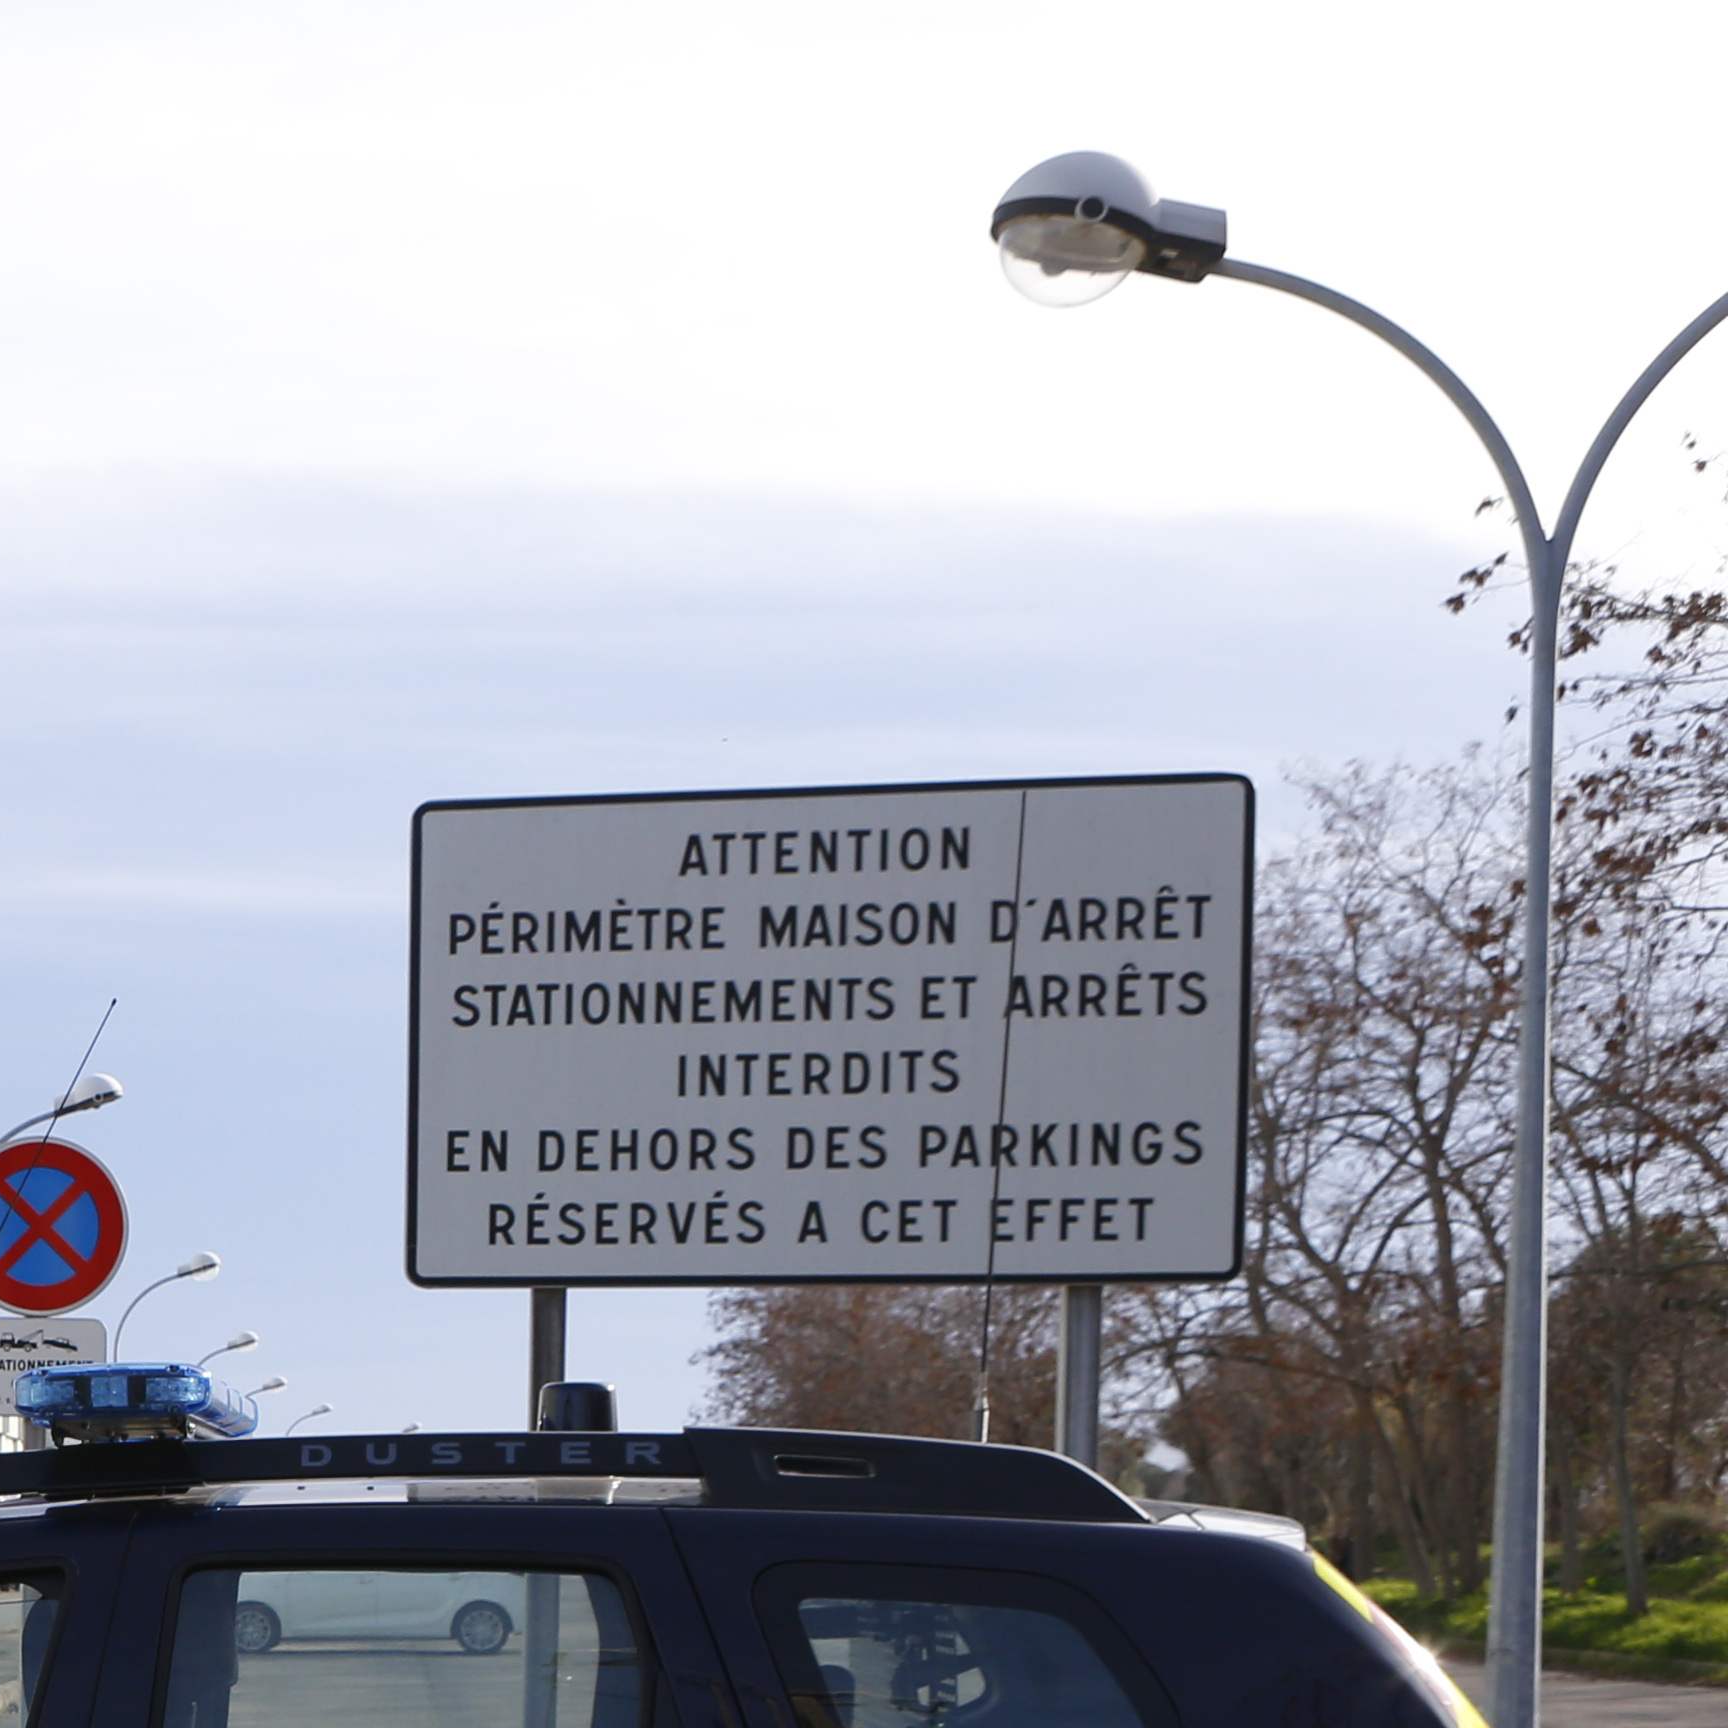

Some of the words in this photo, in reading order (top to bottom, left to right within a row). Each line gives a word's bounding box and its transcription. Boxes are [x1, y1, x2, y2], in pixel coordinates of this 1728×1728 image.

[677, 826, 971, 878] ATTENTION
[447, 900, 727, 957] PÉRIMÈTRE
[757, 900, 957, 950] MAISON
[990, 884, 1213, 944] D'ARRÊT
[451, 975, 897, 1029] STATIONNEMENTS
[919, 975, 979, 1021] ET
[1002, 961, 1209, 1022] ARRÊTS
[676, 1047, 961, 1098] INTERDITS
[445, 1128, 509, 1174] EN
[537, 1126, 757, 1173] DEHORS
[785, 1124, 889, 1171] DES
[918, 1119, 1205, 1170] PARKINGS
[487, 1190, 767, 1247] RÉSERVÉS
[796, 1199, 829, 1245] A
[859, 1197, 959, 1245] CET
[991, 1196, 1156, 1243] EFFET
[300, 1441, 662, 1467] DUSTER
